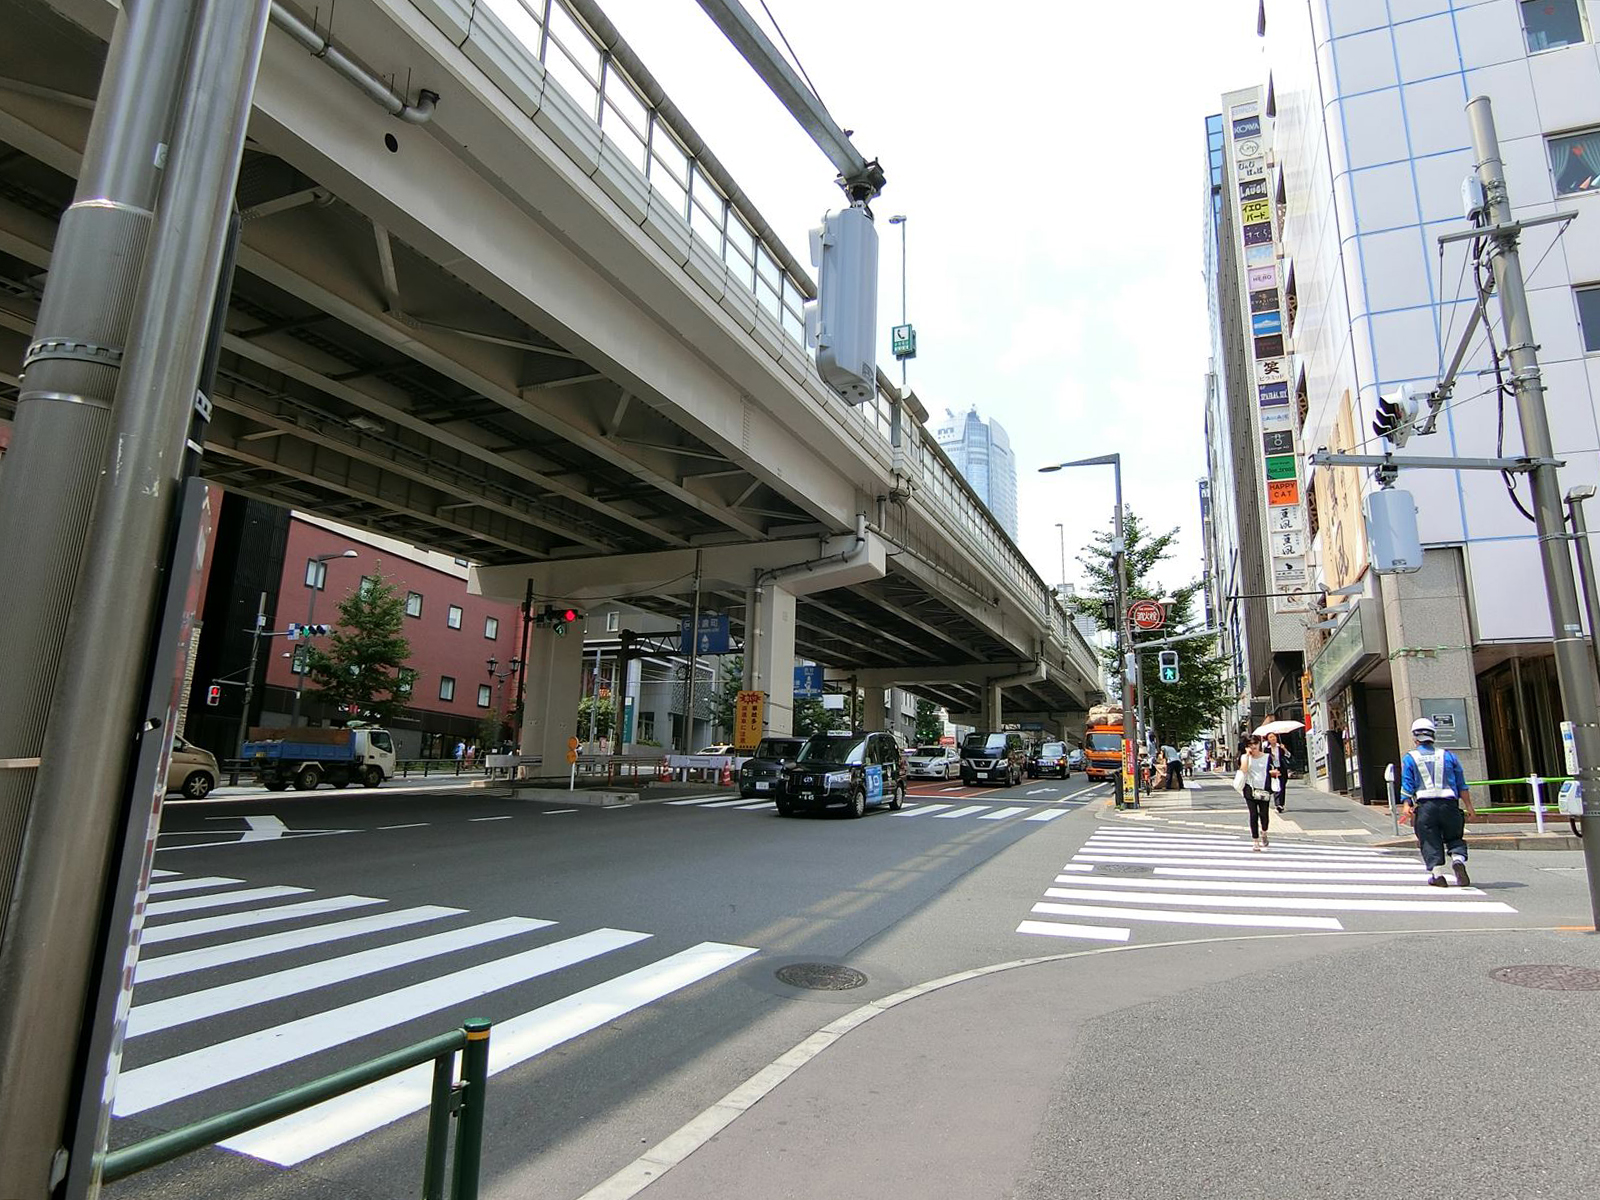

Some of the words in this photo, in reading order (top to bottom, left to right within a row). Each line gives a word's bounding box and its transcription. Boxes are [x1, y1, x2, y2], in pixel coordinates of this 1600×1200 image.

[1242, 203, 1269, 213] イエロー
[1246, 211, 1266, 222] バード
[1263, 360, 1280, 375] 笑
[1269, 481, 1295, 491] HAPPY
[1274, 490, 1292, 498] CAT
